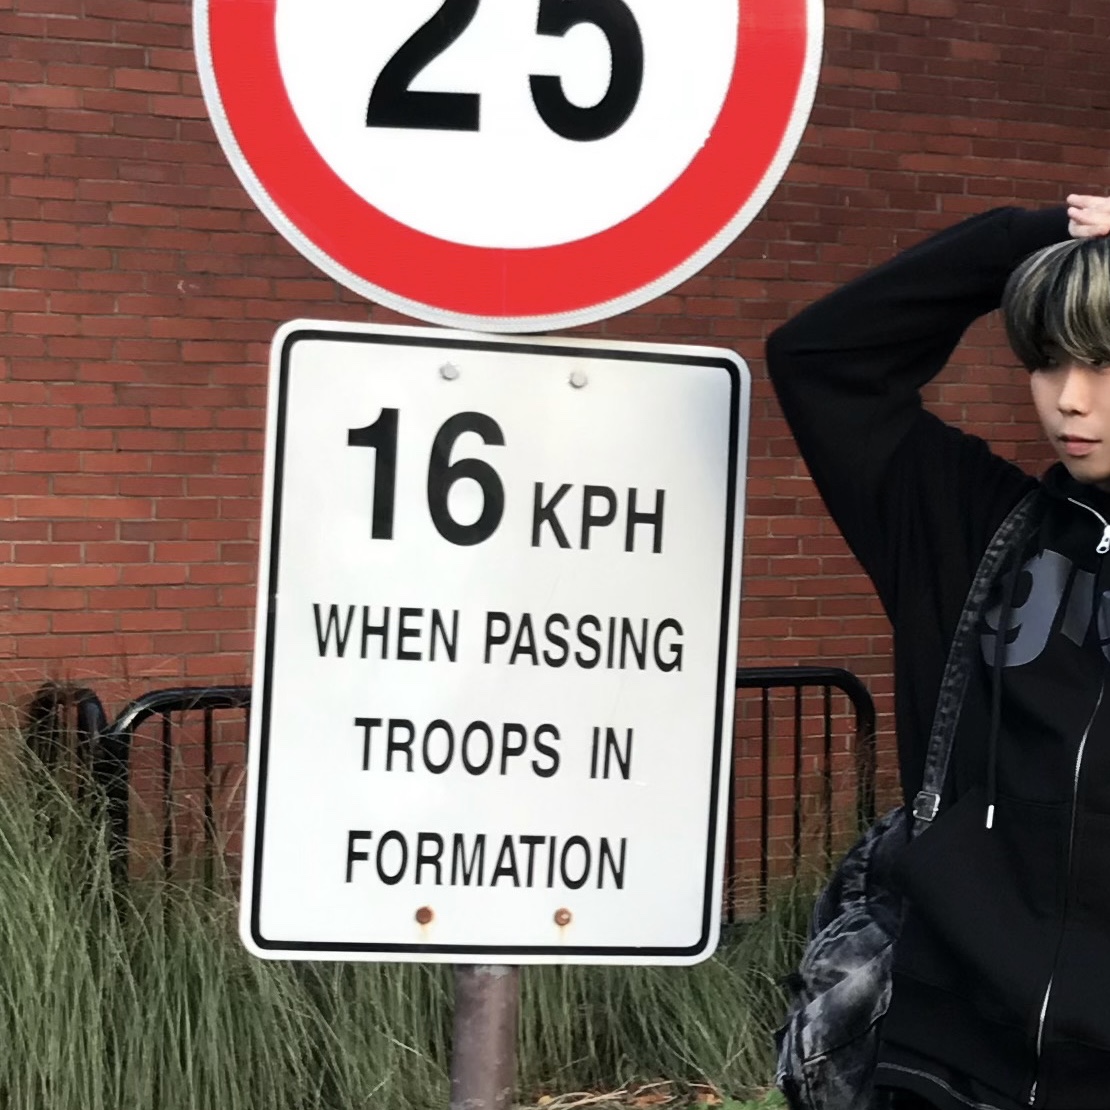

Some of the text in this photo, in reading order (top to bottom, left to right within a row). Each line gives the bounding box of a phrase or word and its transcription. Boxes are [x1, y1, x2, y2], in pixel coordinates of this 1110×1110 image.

[366, 0, 643, 141] 25
[348, 408, 664, 553] 16 KPH
[314, 604, 683, 672] WHEN PASSING
[355, 718, 632, 779] TROOPS IN
[347, 831, 625, 889] FORMATION
